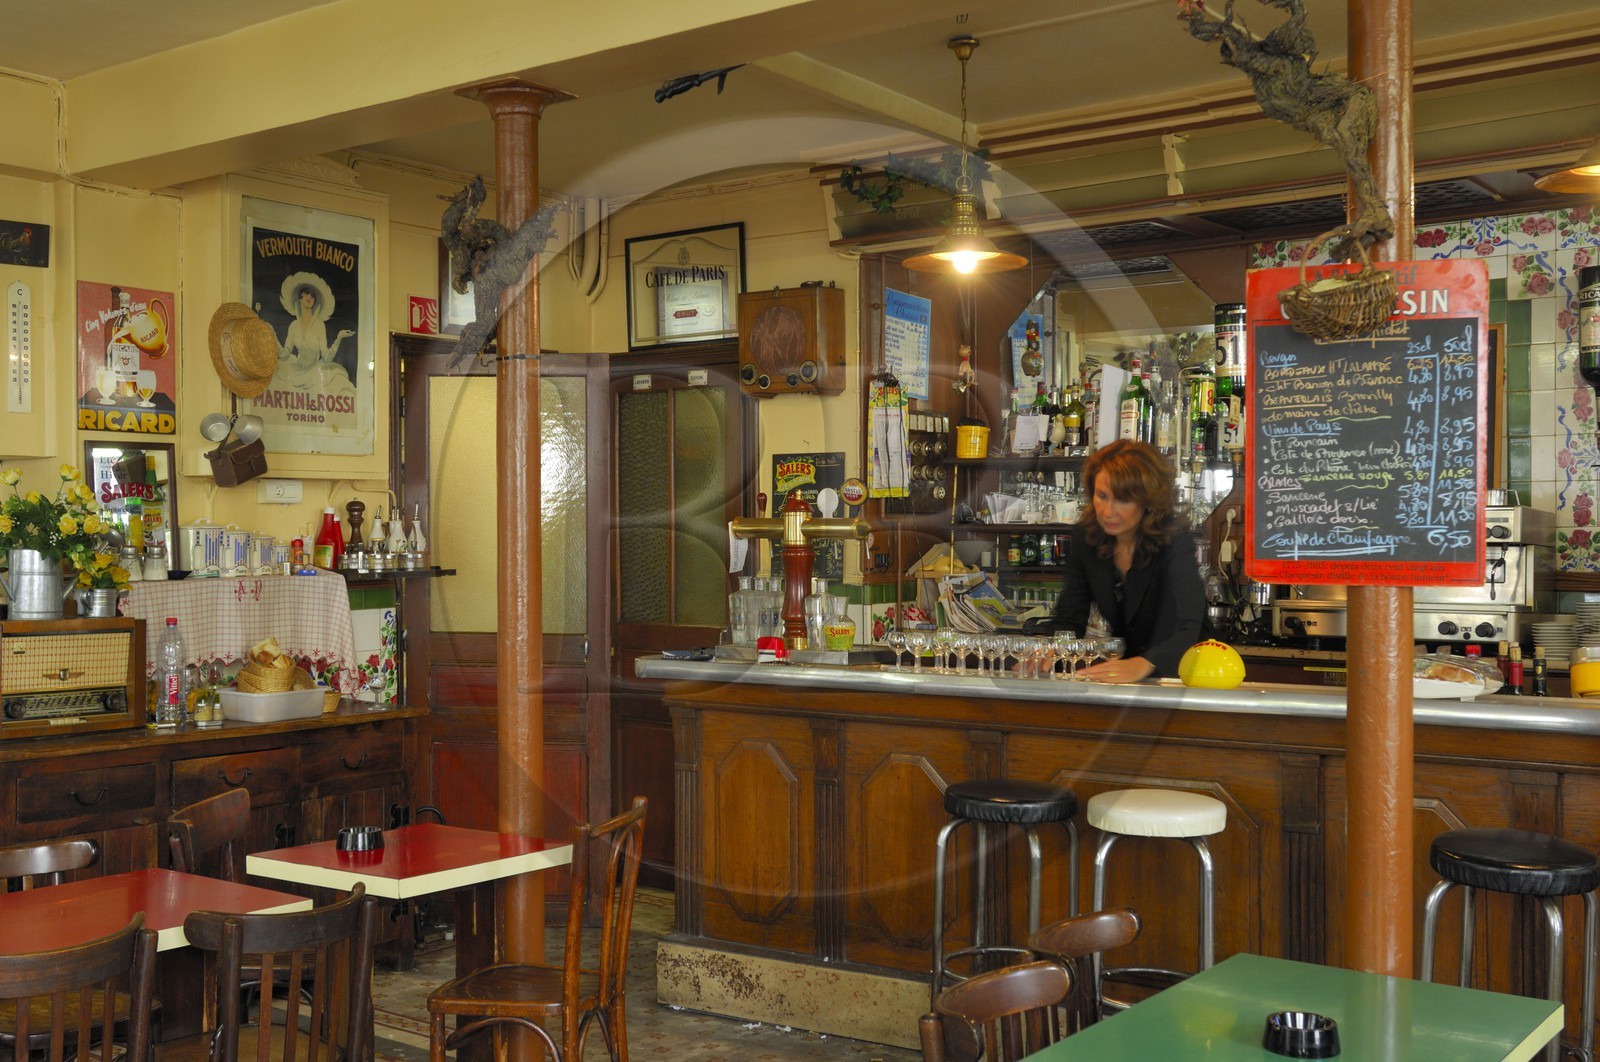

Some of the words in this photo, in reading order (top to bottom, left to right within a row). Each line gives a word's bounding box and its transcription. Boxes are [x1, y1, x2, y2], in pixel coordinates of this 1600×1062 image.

[257, 237, 312, 258] VERMOUTH
[316, 242, 354, 272] BIANCO
[646, 270, 672, 289] CAFÉ
[676, 270, 688, 284] DE
[692, 265, 724, 282] PARIS
[140, 328, 159, 344] RICARD
[1216, 335, 1239, 366] 51
[253, 389, 310, 411] MARTINI
[317, 393, 355, 414] ROSSI
[78, 409, 175, 434] RICARD
[286, 412, 325, 424] TORINO
[1224, 424, 1238, 444] 51
[779, 463, 812, 478] SALERS
[1358, 470, 1395, 490] rouge
[101, 481, 154, 504] SALERS
[1428, 528, 1472, 555] 6,50
[830, 627, 850, 637] SALERS
[170, 675, 178, 696] Vittel
